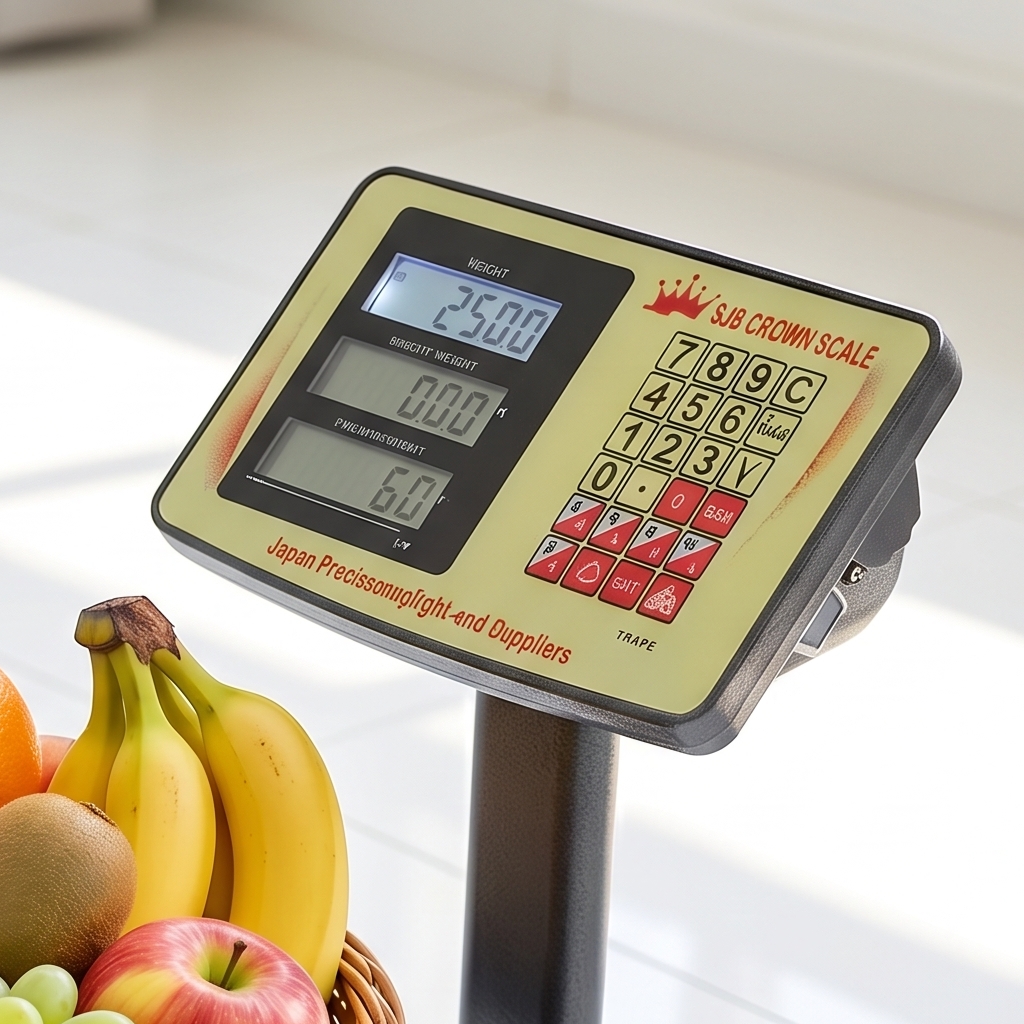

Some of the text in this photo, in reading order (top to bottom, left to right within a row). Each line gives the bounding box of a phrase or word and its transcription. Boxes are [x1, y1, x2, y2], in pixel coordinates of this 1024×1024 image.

[710, 302, 880, 370] SJB CROWN SCALE
[668, 339, 814, 404] 7 8 9 C
[642, 382, 671, 412] 4
[681, 392, 710, 422] 5
[719, 404, 746, 434] 6
[621, 421, 644, 451] 1
[650, 433, 683, 465] 2
[692, 444, 720, 476] 3
[590, 461, 618, 492] 0
[266, 536, 316, 571] Japan
[616, 629, 658, 652] TRAPE
